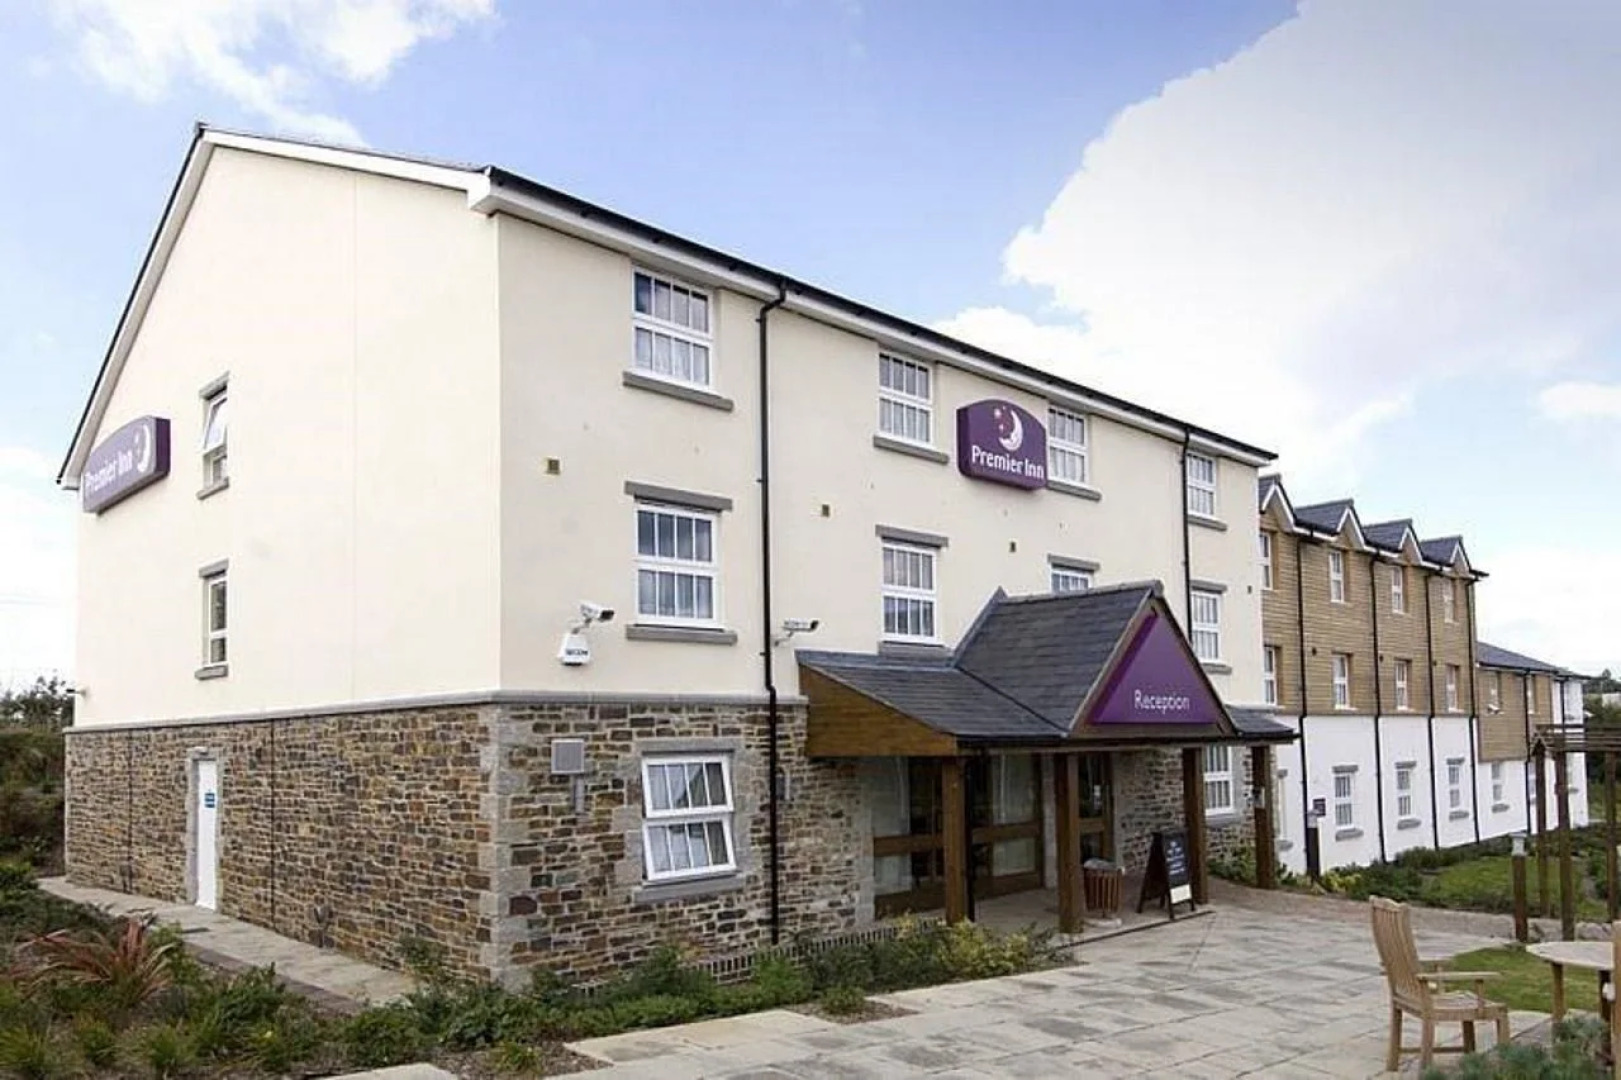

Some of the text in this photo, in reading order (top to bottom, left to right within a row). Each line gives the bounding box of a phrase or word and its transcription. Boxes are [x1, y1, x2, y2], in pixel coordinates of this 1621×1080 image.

[84, 450, 133, 496] Premier Inn
[972, 445, 1044, 479] Premier Inn
[1134, 689, 1190, 715] Reception
